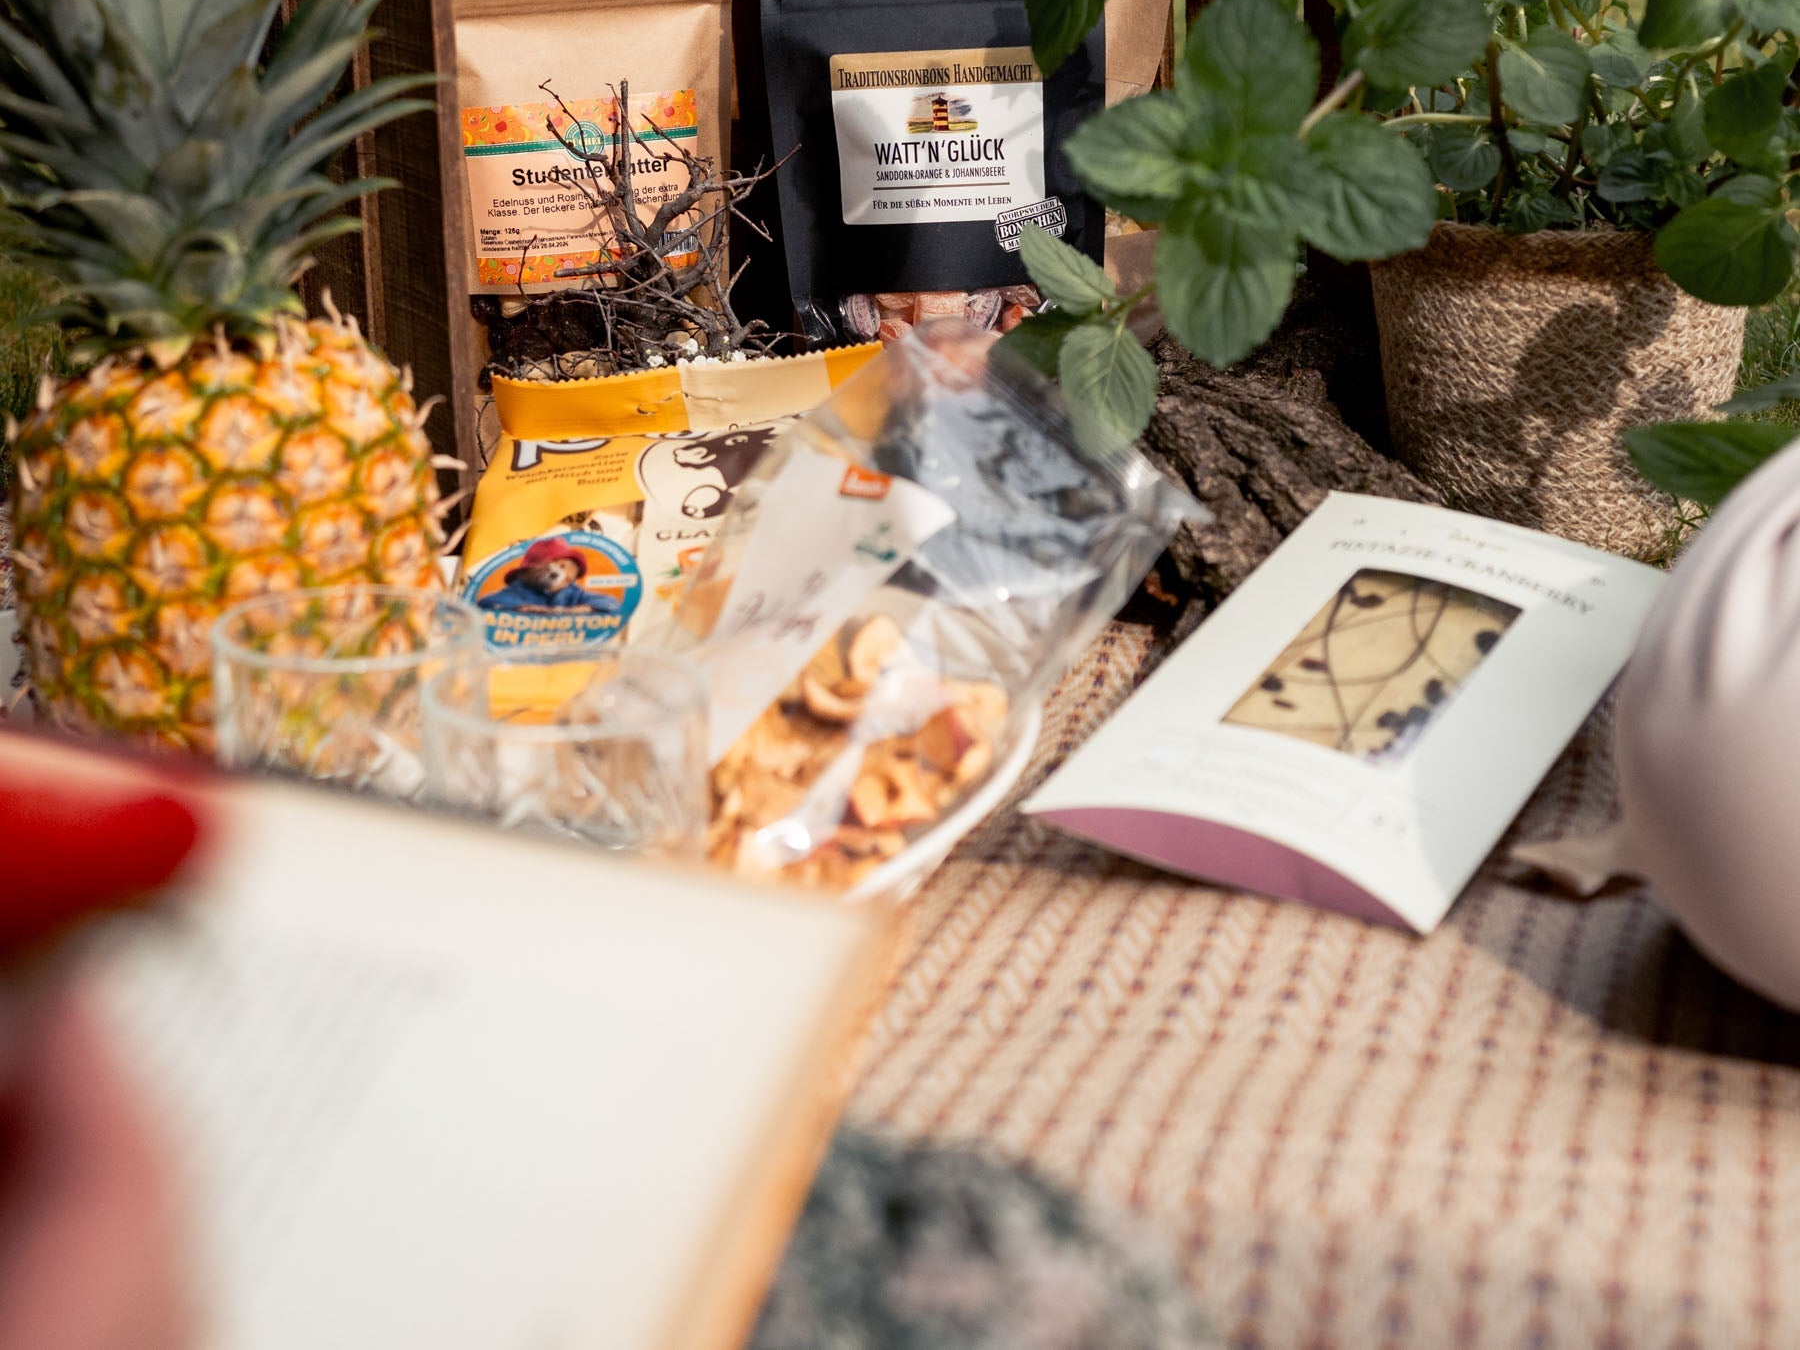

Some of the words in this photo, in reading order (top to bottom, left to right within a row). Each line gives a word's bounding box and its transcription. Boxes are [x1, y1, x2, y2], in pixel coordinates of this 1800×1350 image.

[876, 169, 943, 181] SANDDORN-ORANGE
[944, 169, 950, 178] &
[952, 166, 1006, 178] JOHANNISBEERE
[493, 197, 535, 208] Edelnuss
[537, 195, 556, 205] und
[642, 186, 656, 194] der
[658, 184, 678, 193] extra
[487, 206, 521, 218] Klasse.
[523, 206, 540, 216] Der
[542, 203, 576, 214] leckere
[1001, 200, 1055, 222] WORPSWEDER
[484, 611, 621, 631] ADDINGTON
